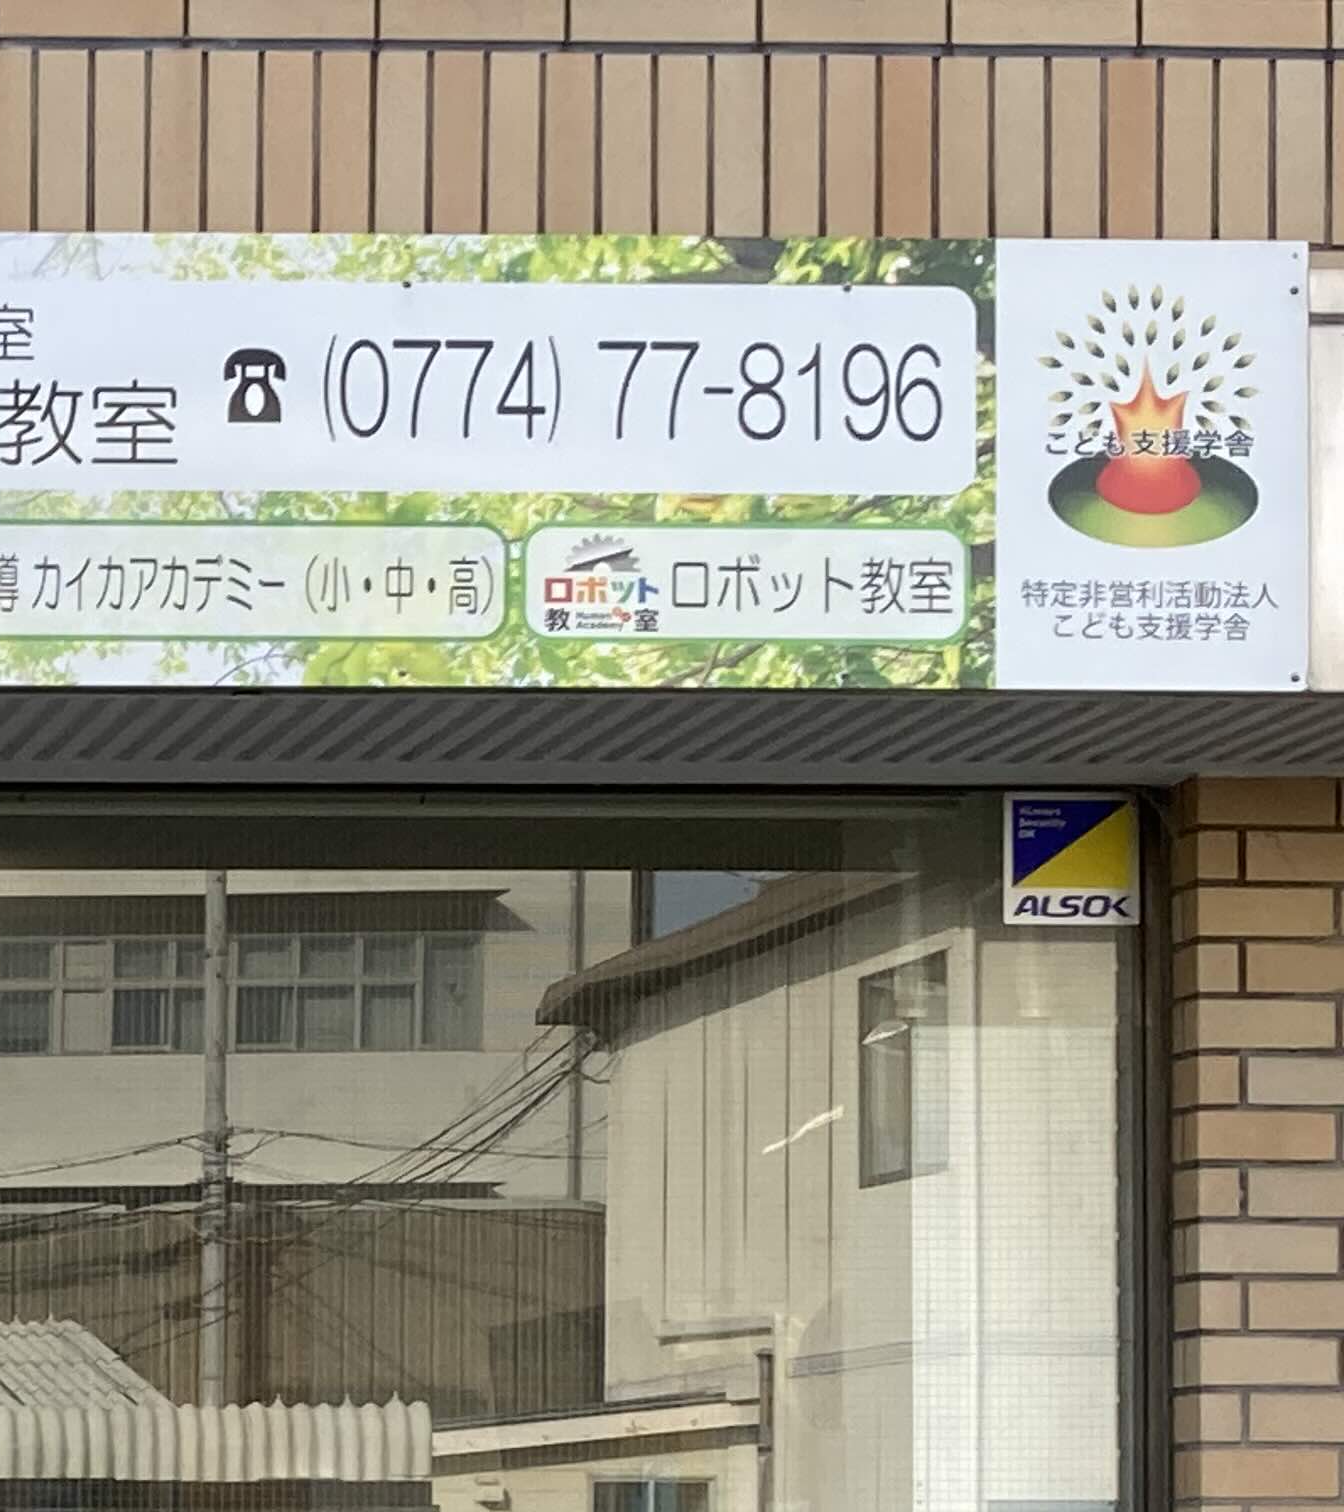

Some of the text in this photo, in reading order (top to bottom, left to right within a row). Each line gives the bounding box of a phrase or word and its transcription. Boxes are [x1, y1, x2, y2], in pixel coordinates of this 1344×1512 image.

[322, 333, 943, 443] (0774) 77-8196
[1044, 428, 1254, 457] こども支援学舎
[32, 556, 285, 612] カイカアカデミー
[544, 576, 659, 604] ロボット
[672, 553, 953, 615] ロボット教室
[1020, 578, 1279, 609] 特定非営利活動法人
[1052, 612, 1250, 641] こども支援学舎
[1014, 895, 1131, 918] ALSOK
